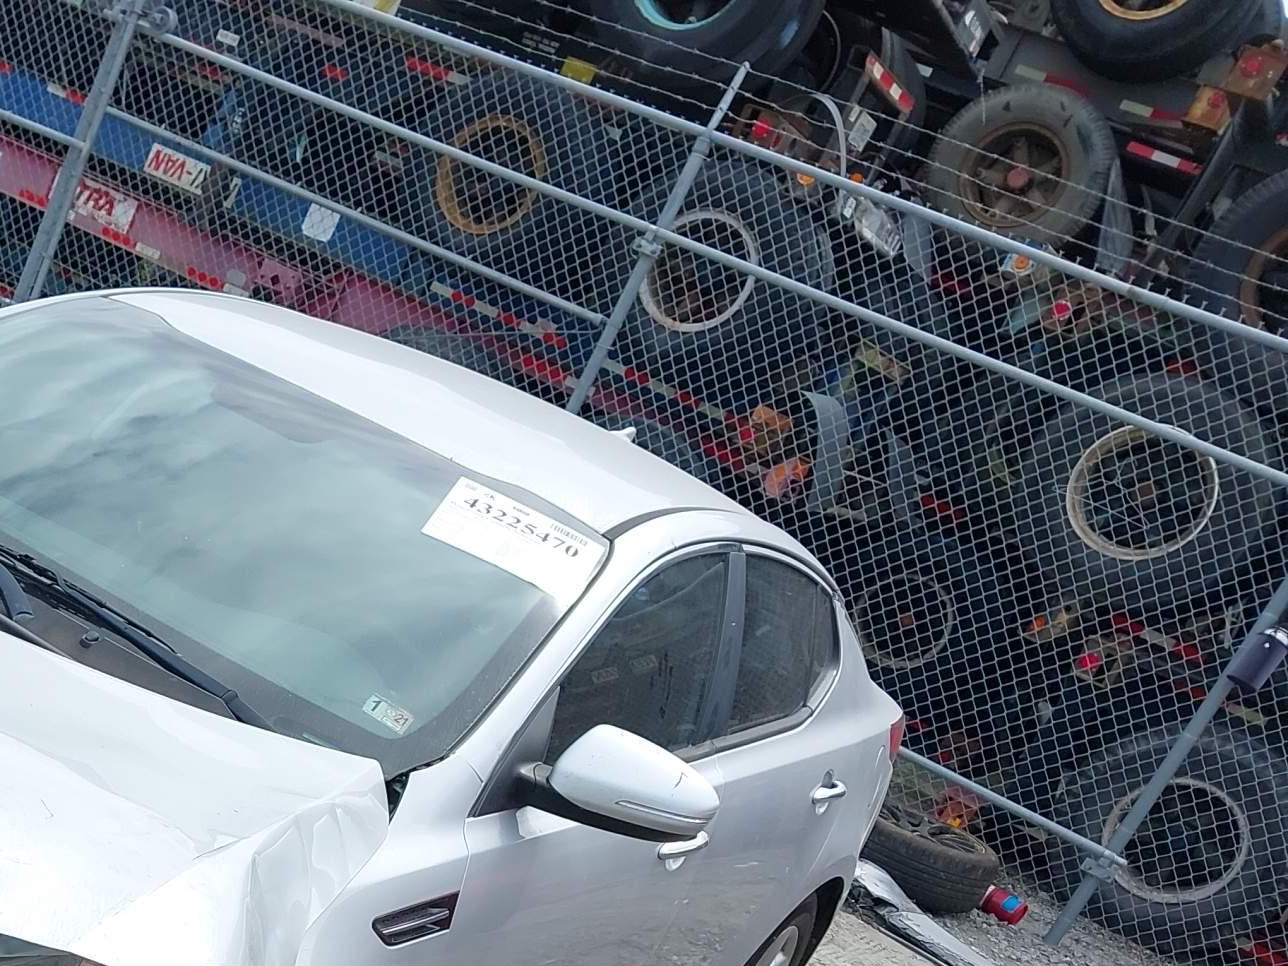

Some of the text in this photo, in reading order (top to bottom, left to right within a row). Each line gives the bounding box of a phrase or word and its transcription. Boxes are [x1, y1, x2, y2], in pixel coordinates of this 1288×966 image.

[463, 498, 580, 558] 43225470
[371, 700, 409, 727] 1 21
